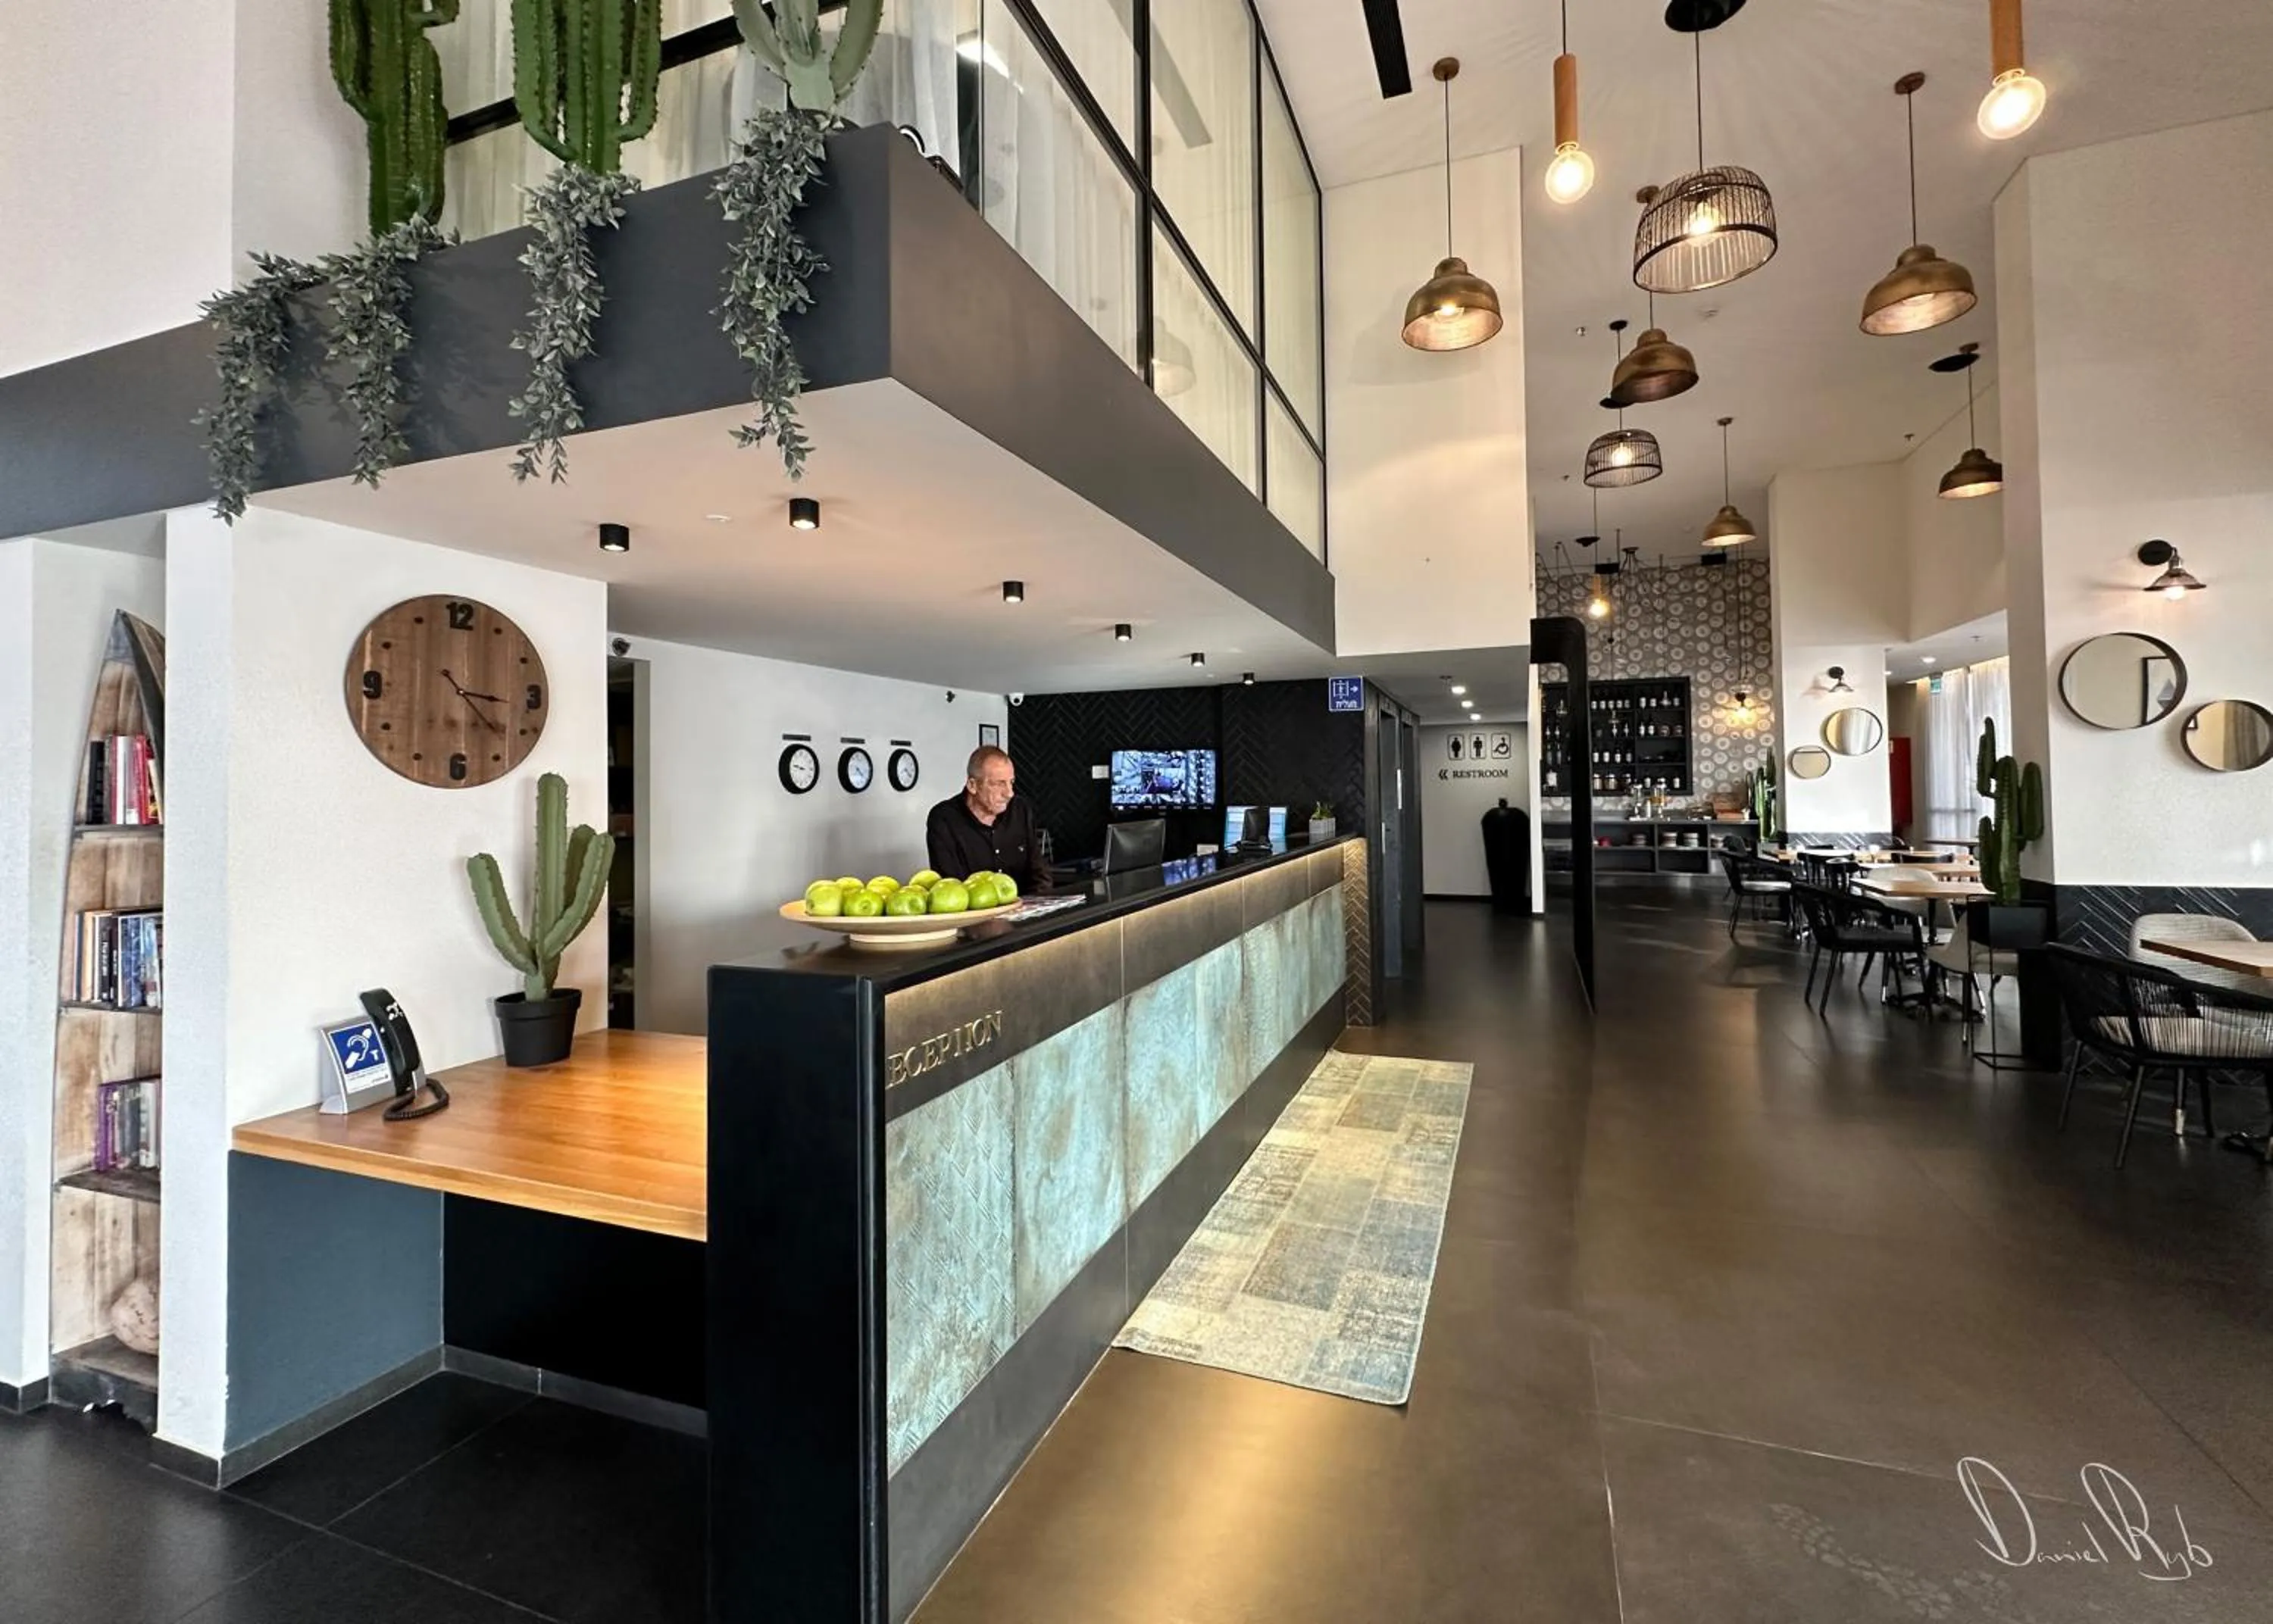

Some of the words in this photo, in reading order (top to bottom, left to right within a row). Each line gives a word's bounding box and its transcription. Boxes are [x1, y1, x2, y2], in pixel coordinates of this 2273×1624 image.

[446, 601, 474, 631] 12
[363, 670, 382, 699] 9
[526, 685, 542, 710] 3
[449, 752, 467, 781] 6
[1452, 769, 1509, 779] RESTROOM
[885, 1010, 1002, 1090] ECEPTION
